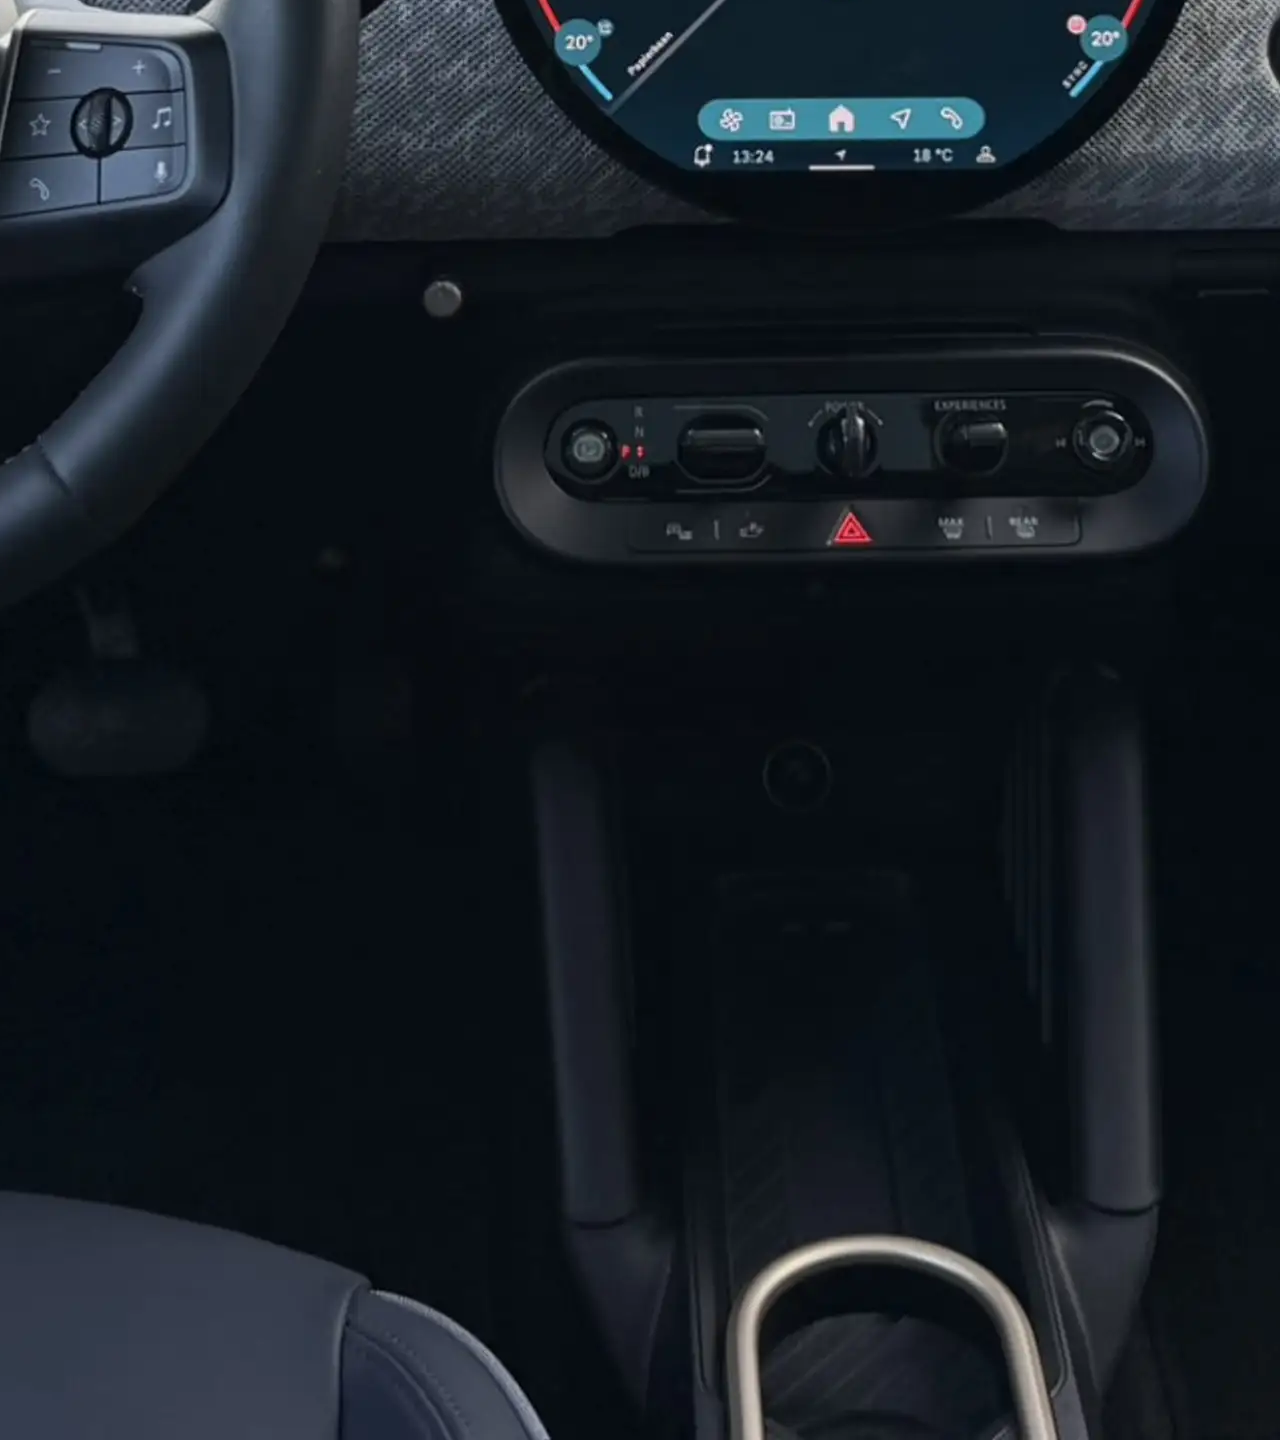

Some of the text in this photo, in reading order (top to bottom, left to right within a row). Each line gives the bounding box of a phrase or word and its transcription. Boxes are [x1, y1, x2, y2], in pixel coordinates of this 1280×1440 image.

[732, 149, 775, 164] 13:24
[913, 148, 931, 163] 18
[933, 399, 1007, 411] EXPERIENCES
